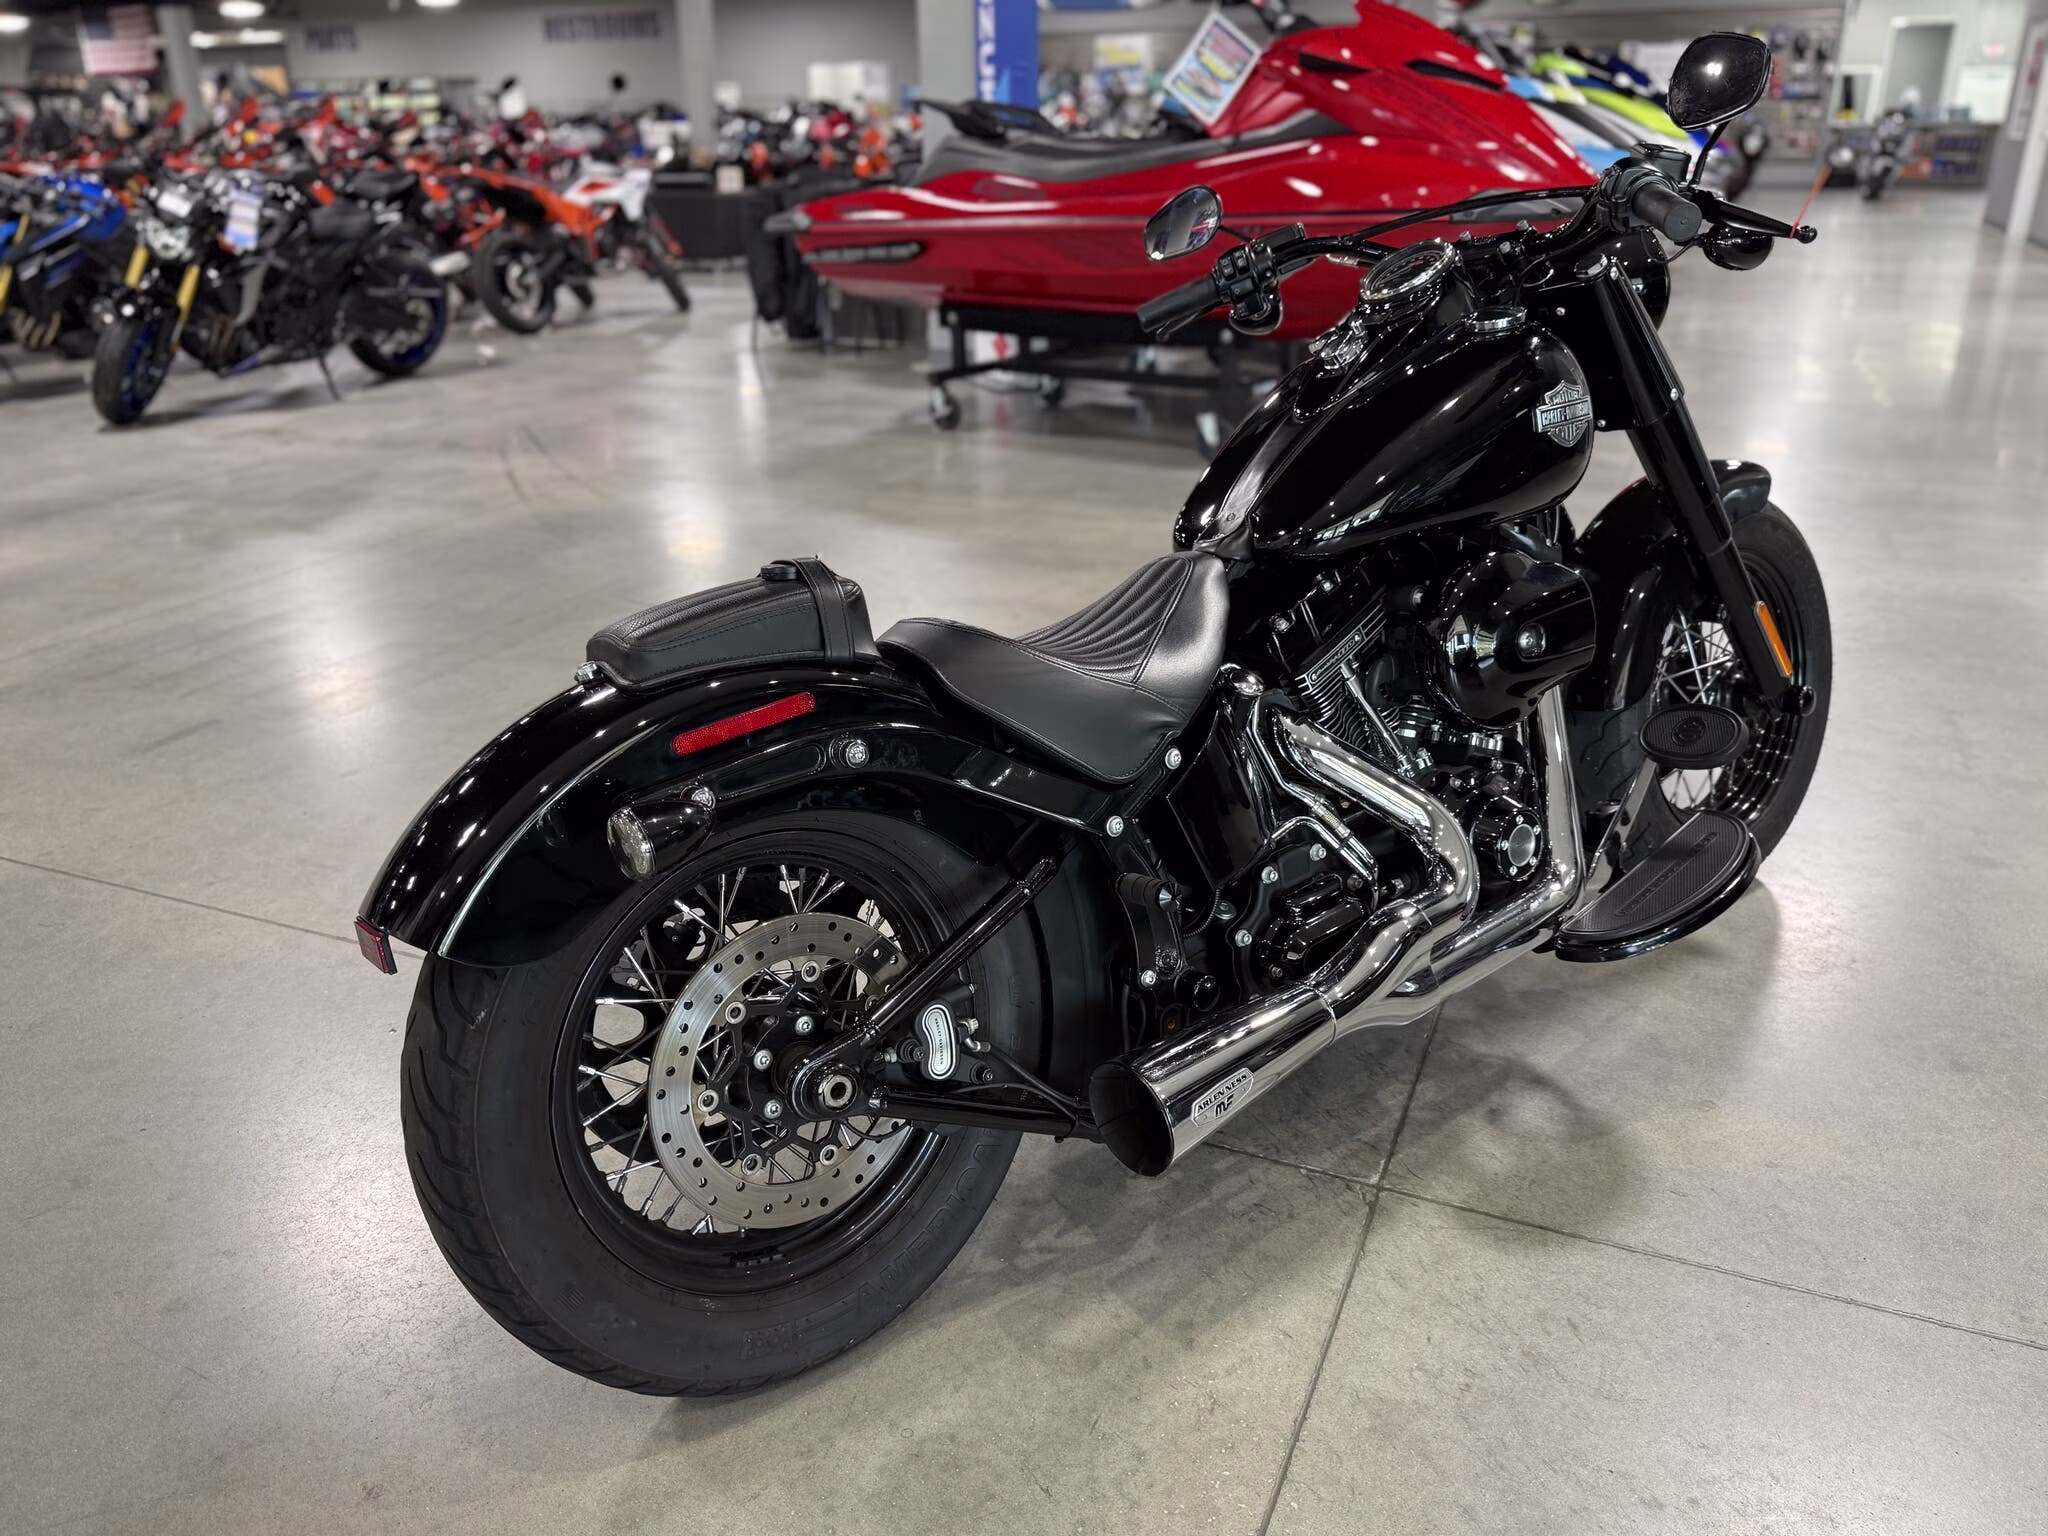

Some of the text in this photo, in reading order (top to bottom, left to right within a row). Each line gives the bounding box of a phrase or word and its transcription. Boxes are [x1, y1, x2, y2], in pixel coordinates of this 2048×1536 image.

[1197, 1073, 1248, 1112] ARLEN NESS
[857, 1128, 1004, 1314] AMERICA
